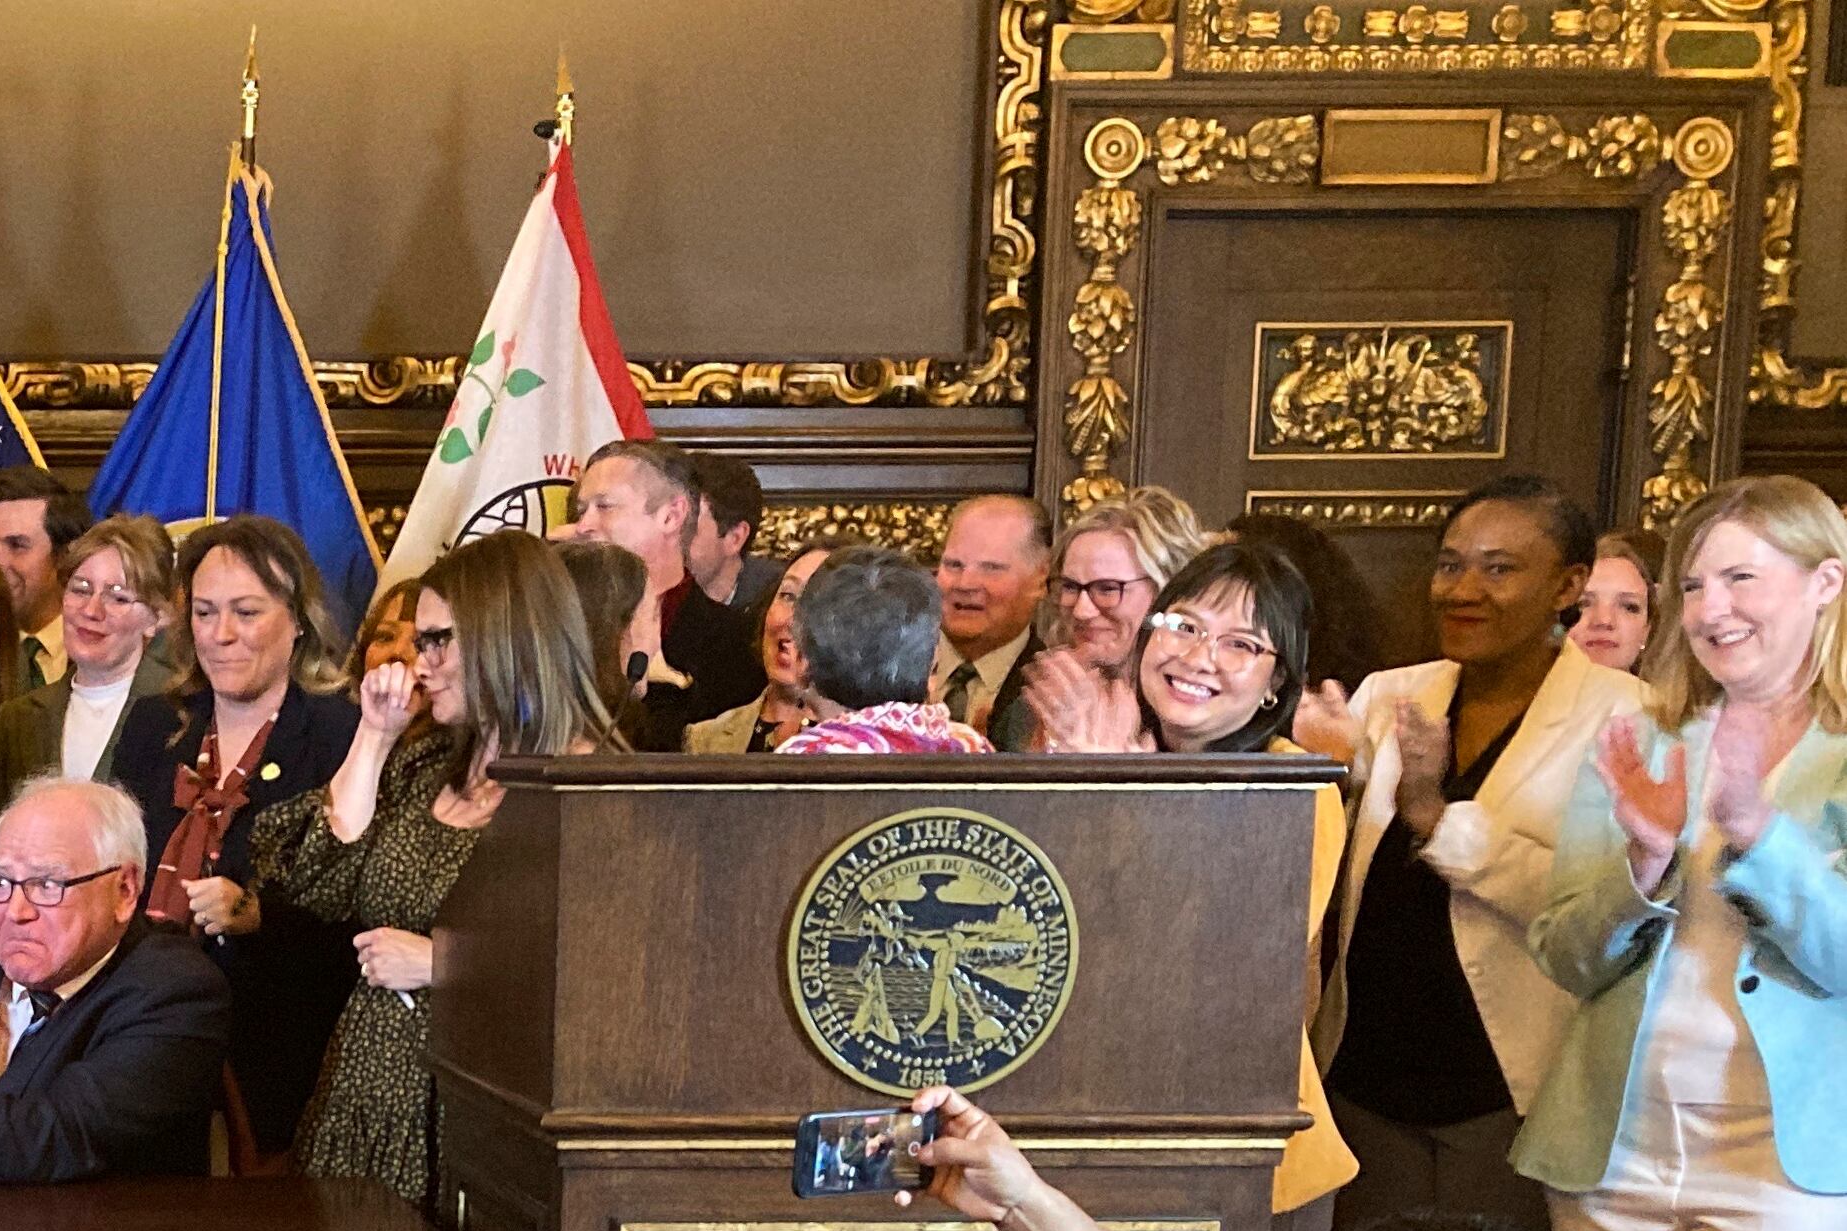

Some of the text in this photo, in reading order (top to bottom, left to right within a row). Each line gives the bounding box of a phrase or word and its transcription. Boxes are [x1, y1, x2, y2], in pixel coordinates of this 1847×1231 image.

[941, 859, 965, 872] DU
[968, 864, 1012, 892] NORD
[800, 819, 1067, 1056] THE GREAT SEAL OF THE STATE OF MINNESOTA
[898, 1066, 947, 1088] 1858
